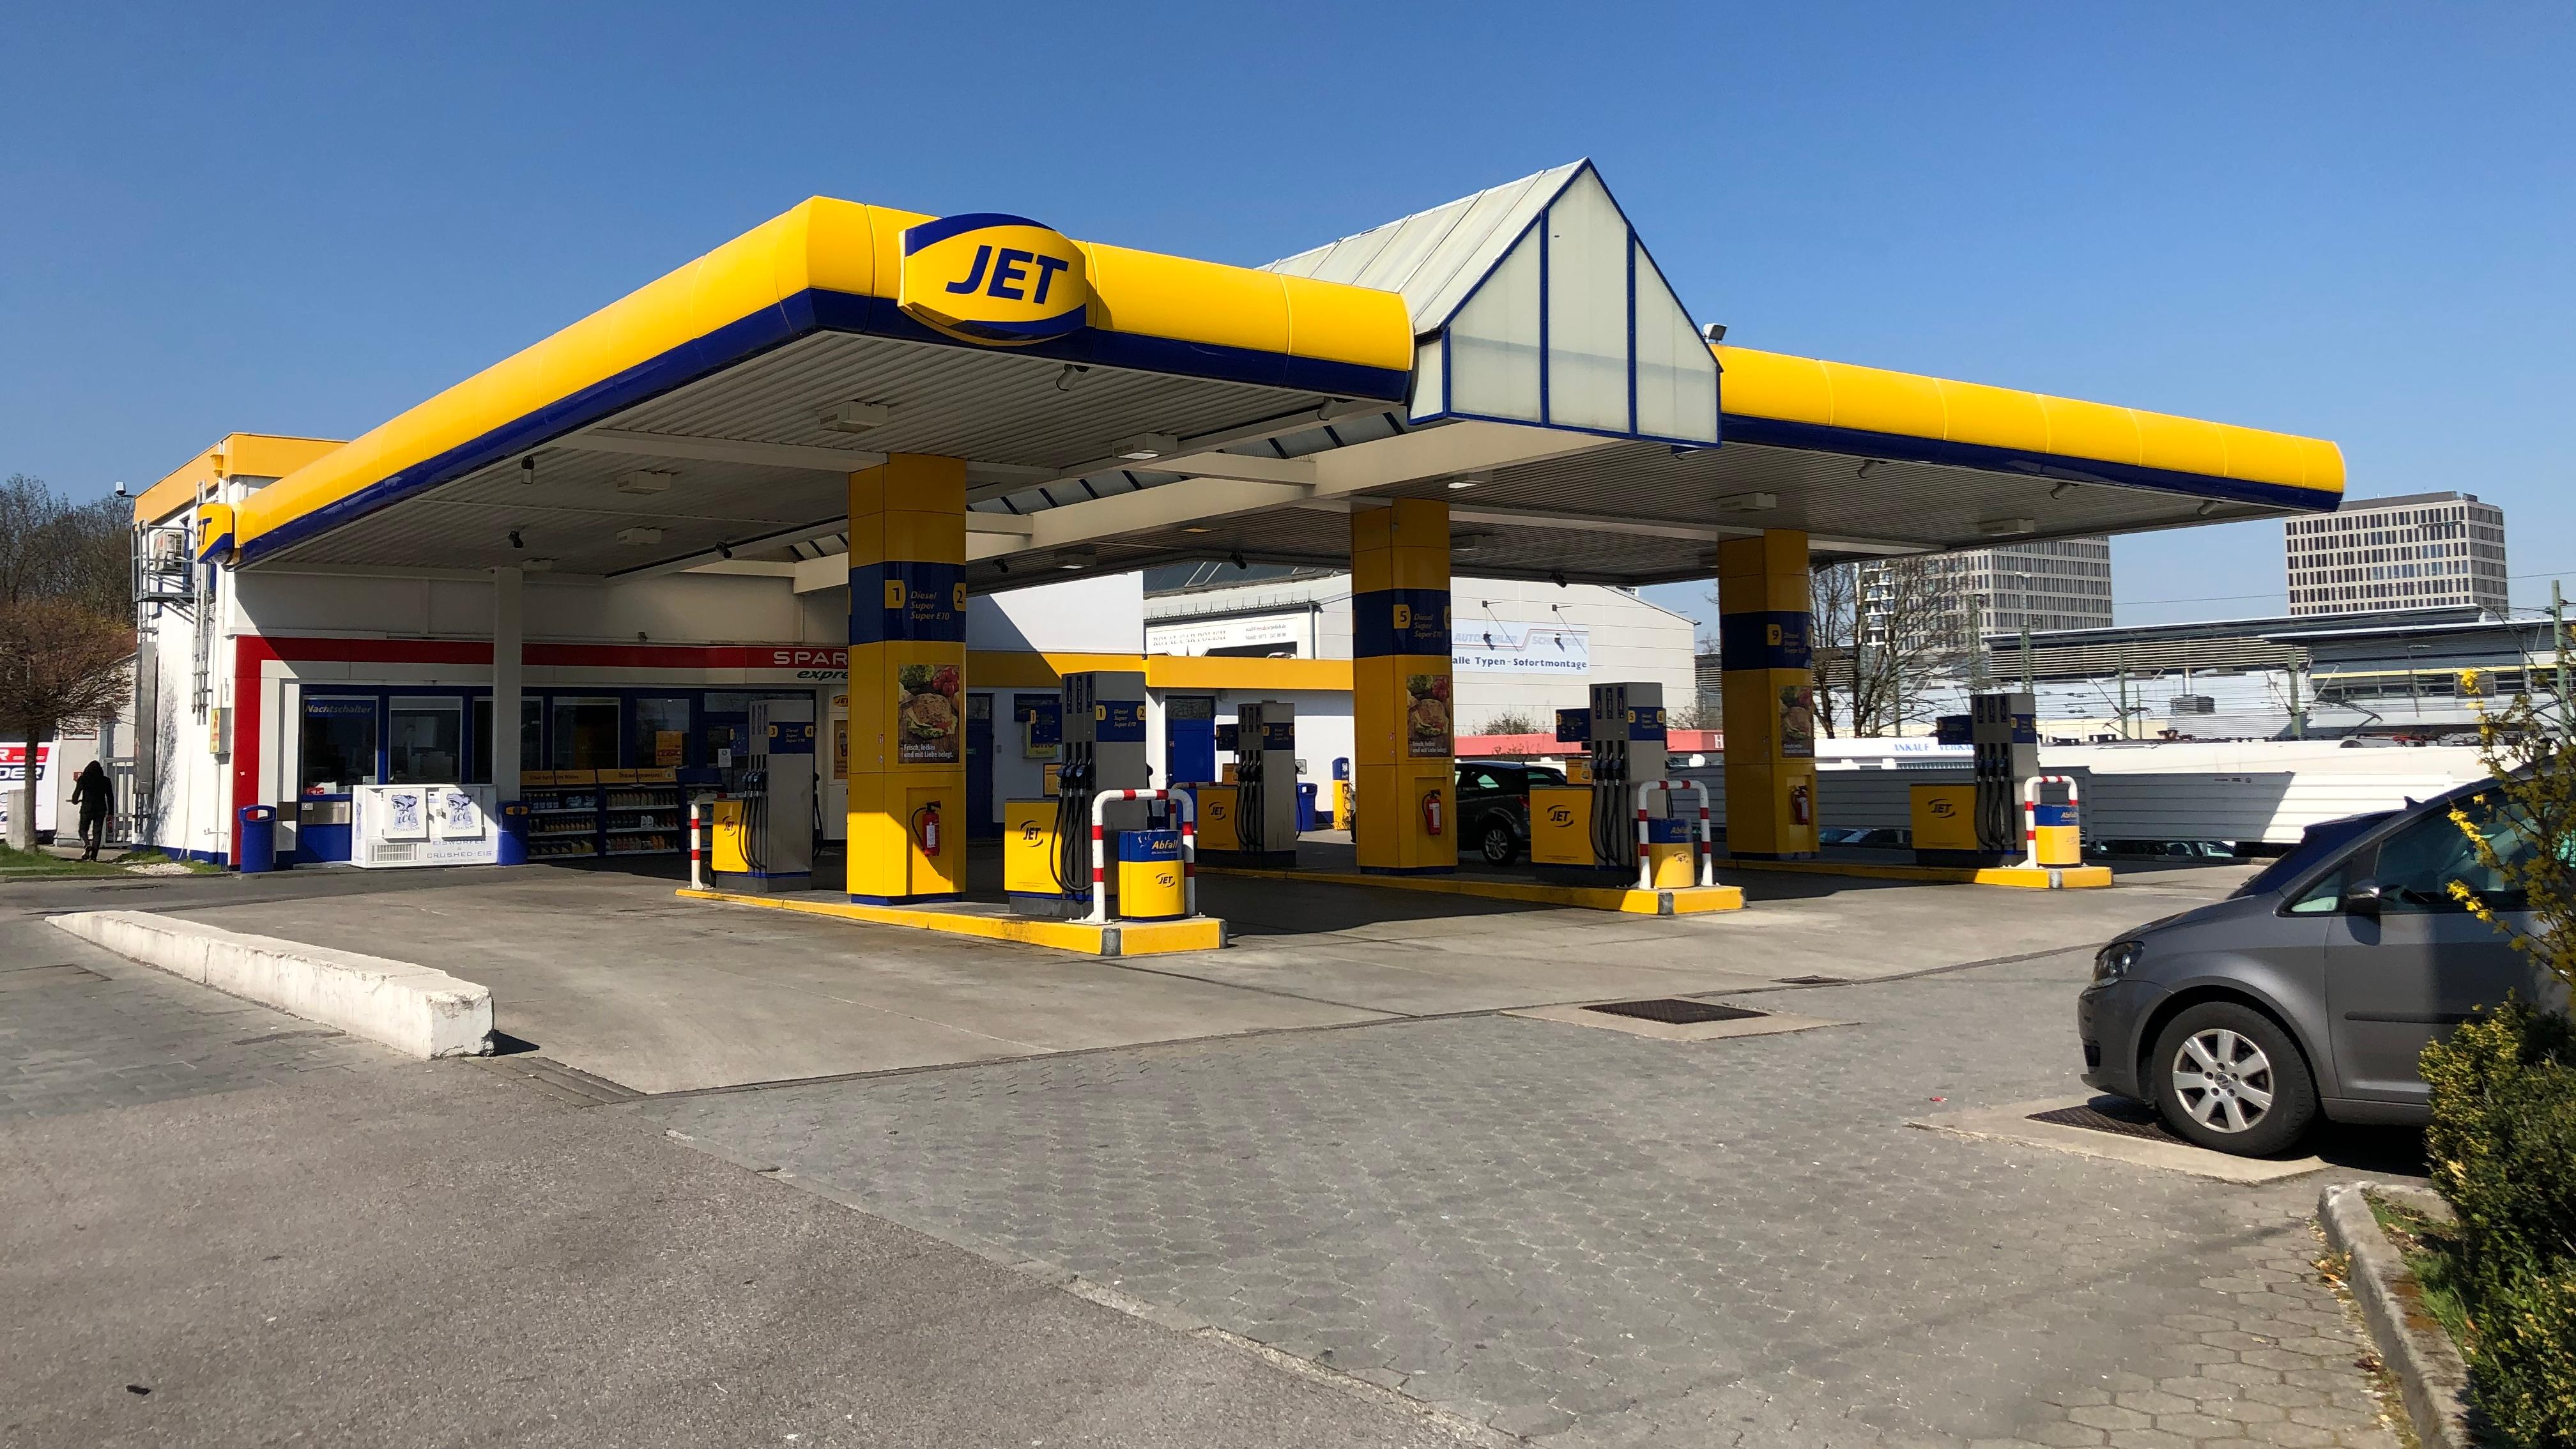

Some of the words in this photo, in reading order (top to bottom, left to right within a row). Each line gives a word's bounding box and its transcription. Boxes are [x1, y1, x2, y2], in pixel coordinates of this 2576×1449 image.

[945, 245, 1069, 305] JET
[893, 587, 900, 601] 1
[910, 591, 937, 599] Diesel
[957, 590, 963, 604] 2
[910, 601, 935, 611] Super
[910, 611, 935, 622] Super
[936, 612, 950, 620] E10
[1400, 610, 1407, 622] 5
[1153, 636, 1178, 646] ROYAL
[1179, 633, 1196, 643] CAR
[1197, 631, 1226, 641] POLISH
[1772, 629, 1779, 640] 9
[773, 651, 848, 665] SPAR
[1452, 656, 1471, 665] alle
[1475, 657, 1506, 667] Typen
[1513, 658, 1588, 670] Sofortmontage
[796, 670, 848, 681] expre
[305, 705, 371, 713] Nachtschalter
[1099, 708, 1103, 717] 1
[1140, 709, 1145, 717] 2
[771, 727, 776, 735] 3
[1211, 807, 1224, 816] JET
[1931, 804, 1953, 813] JET
[1550, 810, 1570, 822] JET
[724, 821, 735, 831] JET
[1022, 827, 1041, 840] JET
[1151, 839, 1178, 849] Abfall
[426, 850, 492, 859] CRUSHED-EIS
[1158, 875, 1174, 885] JET
